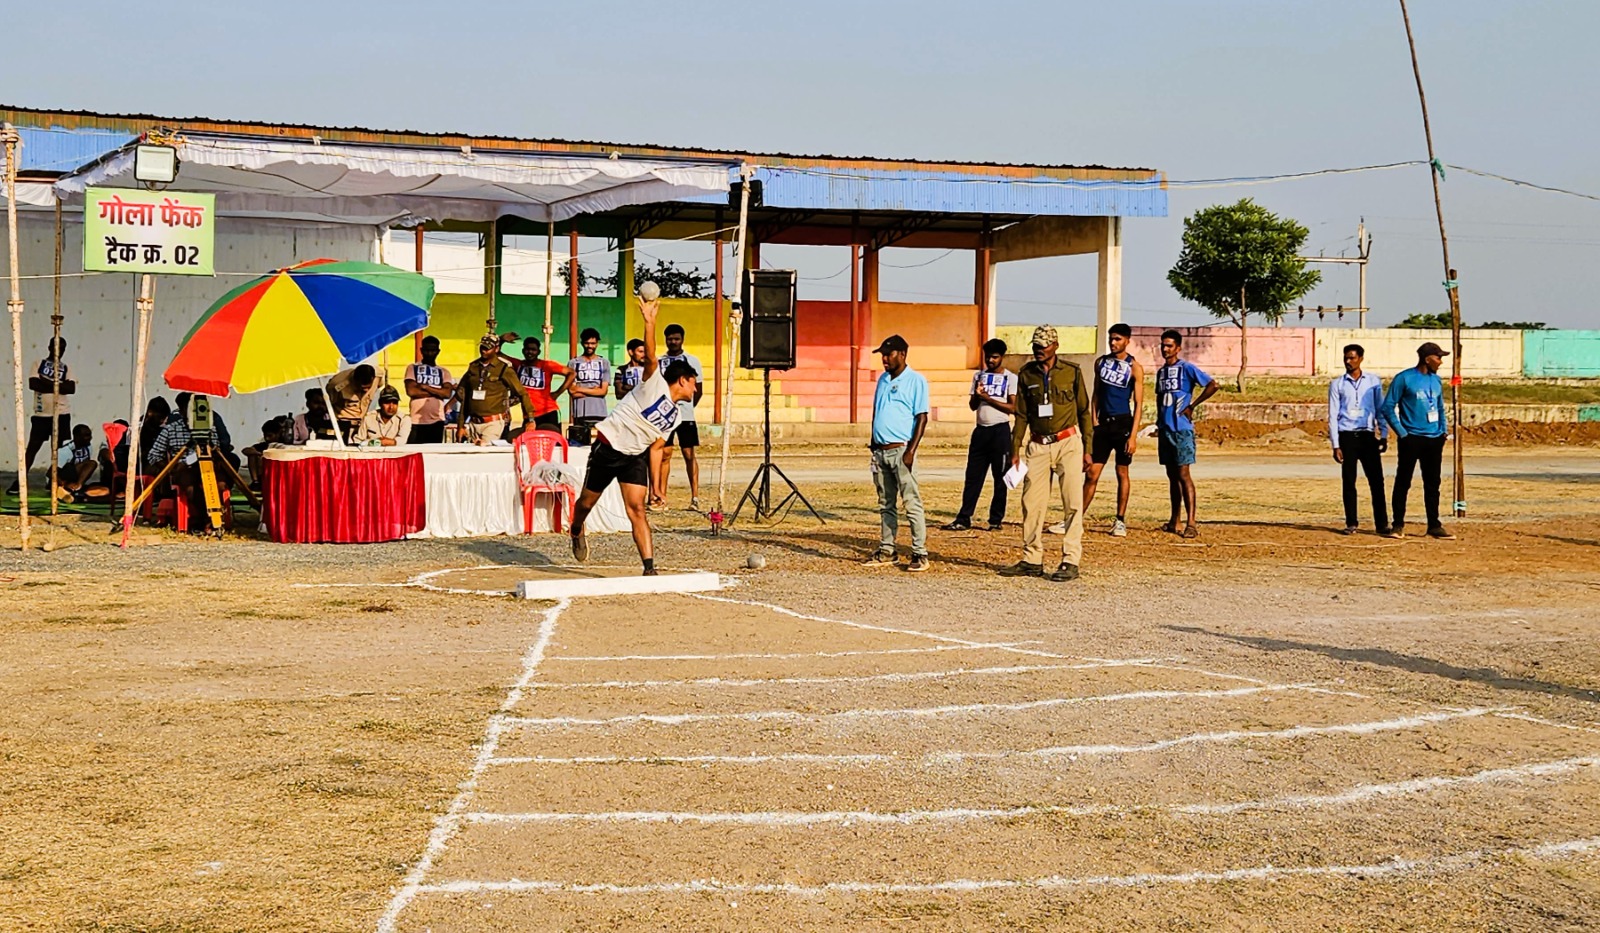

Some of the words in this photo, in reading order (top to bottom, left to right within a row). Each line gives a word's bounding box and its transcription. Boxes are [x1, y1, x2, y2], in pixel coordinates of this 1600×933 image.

[98, 195, 155, 226] गोला
[159, 198, 204, 228] फेंक
[104, 236, 138, 264] ट्रैक
[174, 245, 199, 265] 02
[417, 374, 440, 386] 0730
[520, 375, 540, 387] 0767
[1100, 366, 1125, 385] 0752
